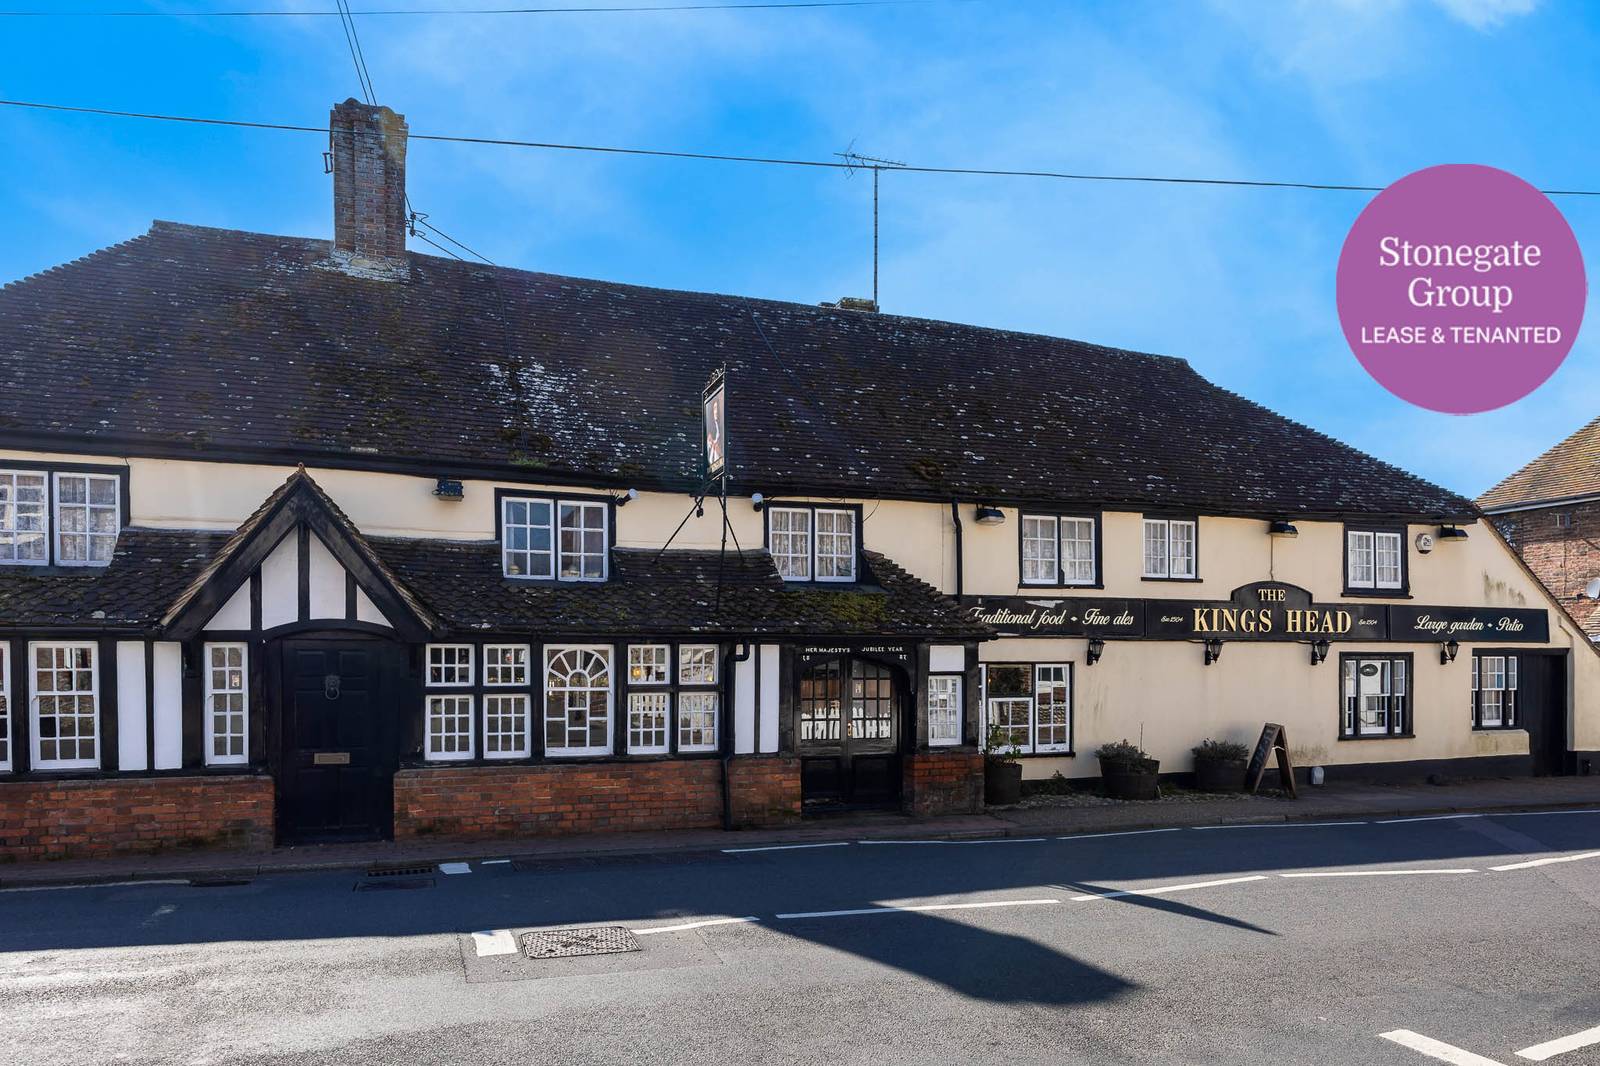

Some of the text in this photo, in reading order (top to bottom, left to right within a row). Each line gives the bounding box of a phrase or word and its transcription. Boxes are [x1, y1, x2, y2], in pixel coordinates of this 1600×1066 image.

[1257, 588, 1286, 602] THE
[969, 606, 1134, 630] Taditional food Fine ales
[1192, 608, 1352, 633] KINGS HEAD
[1414, 614, 1524, 635] Large garden Patio
